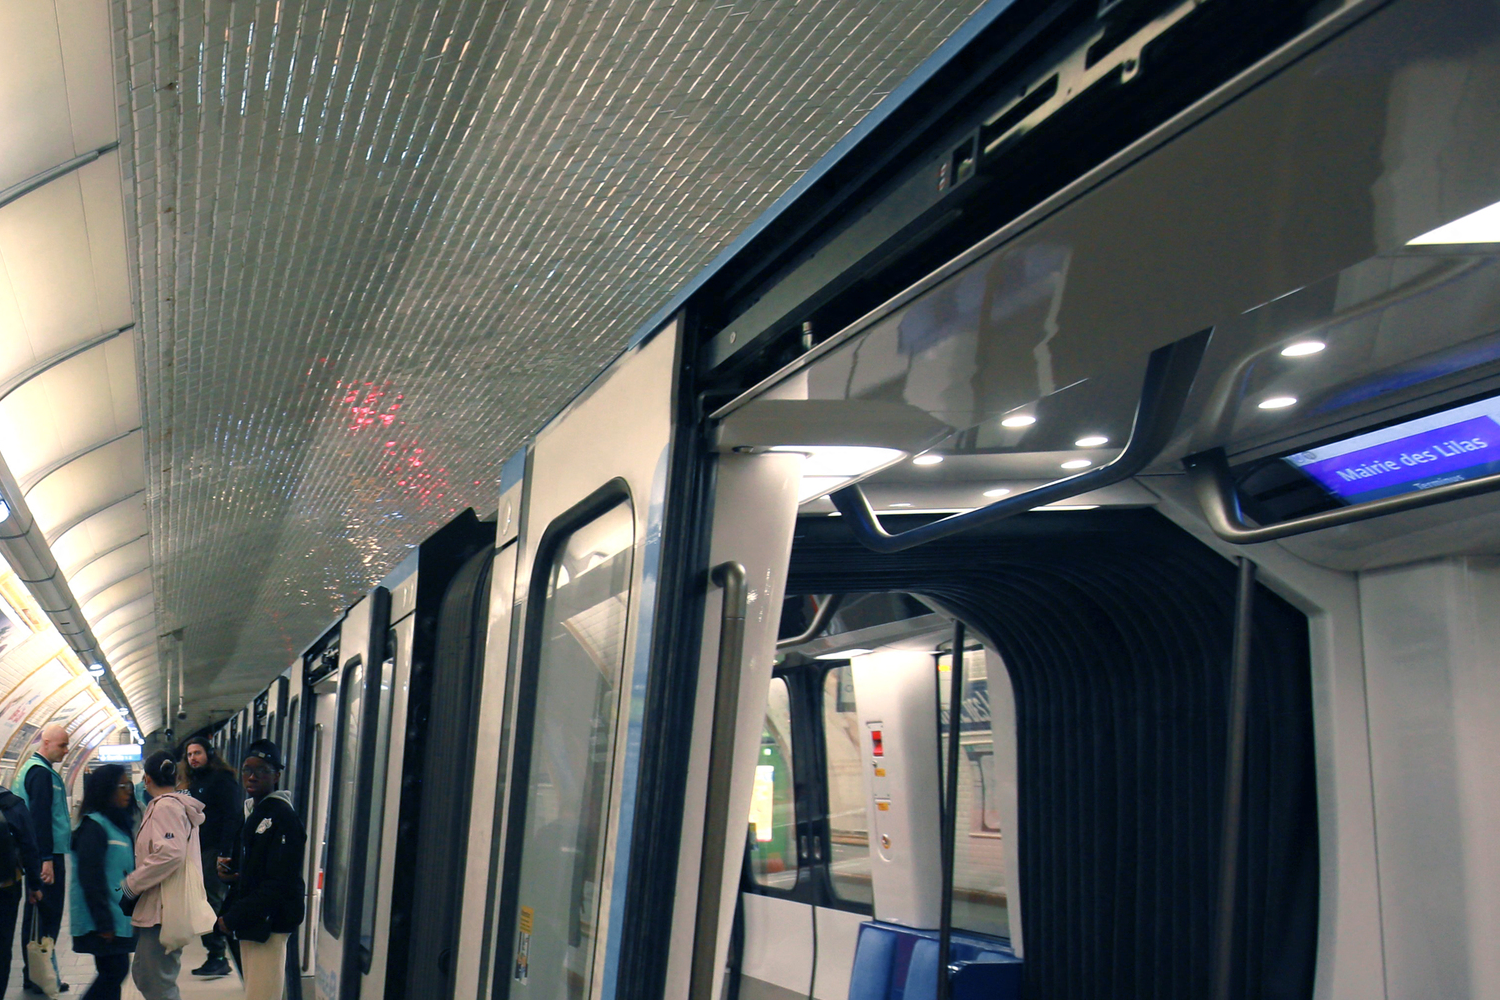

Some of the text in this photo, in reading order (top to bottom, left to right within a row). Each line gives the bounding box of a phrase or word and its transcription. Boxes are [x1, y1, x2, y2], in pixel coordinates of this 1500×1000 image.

[1336, 437, 1488, 482] Mairie des Lilas
